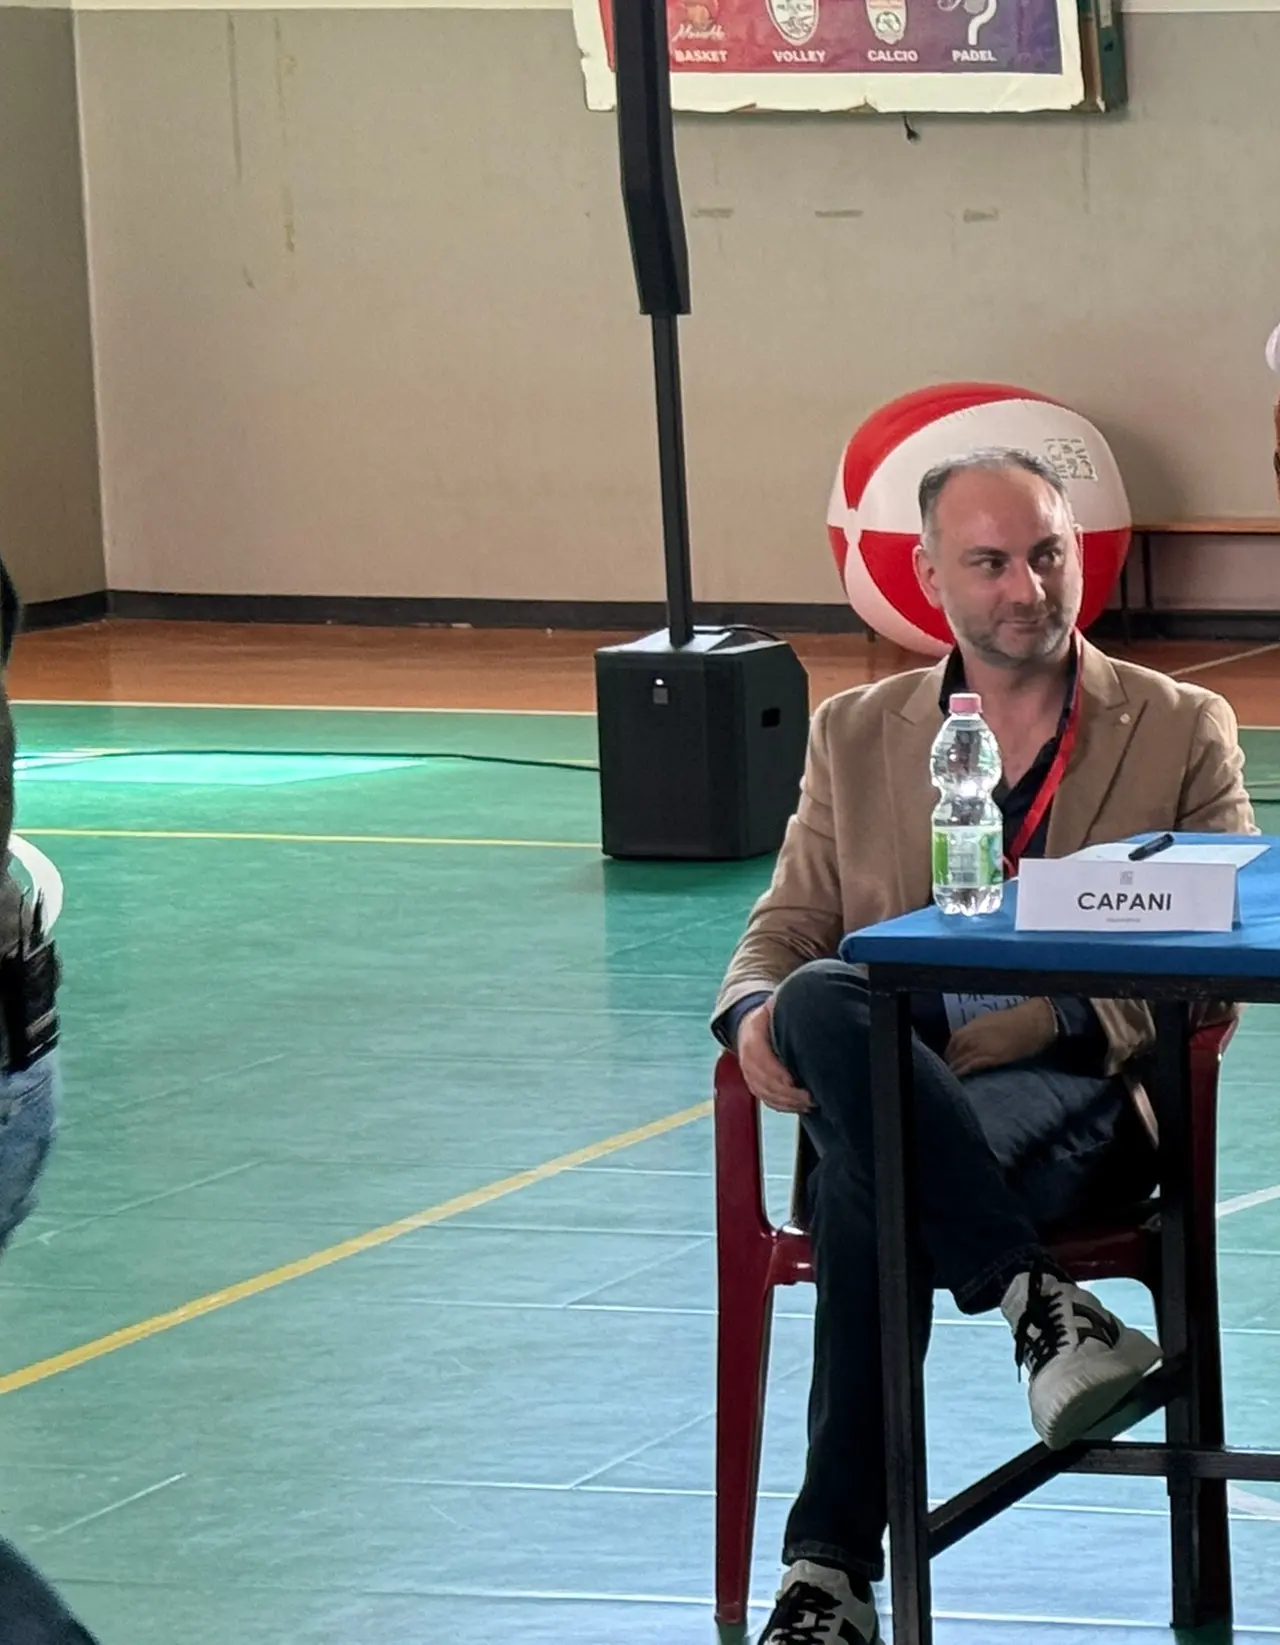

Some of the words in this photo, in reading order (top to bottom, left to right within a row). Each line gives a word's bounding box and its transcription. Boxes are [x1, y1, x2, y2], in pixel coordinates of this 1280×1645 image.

[674, 50, 728, 63] BASKET
[772, 50, 826, 63] VOLLEY
[868, 50, 918, 62] CALCIO
[952, 50, 997, 62] PADEL
[1077, 892, 1171, 911] CAPANI
